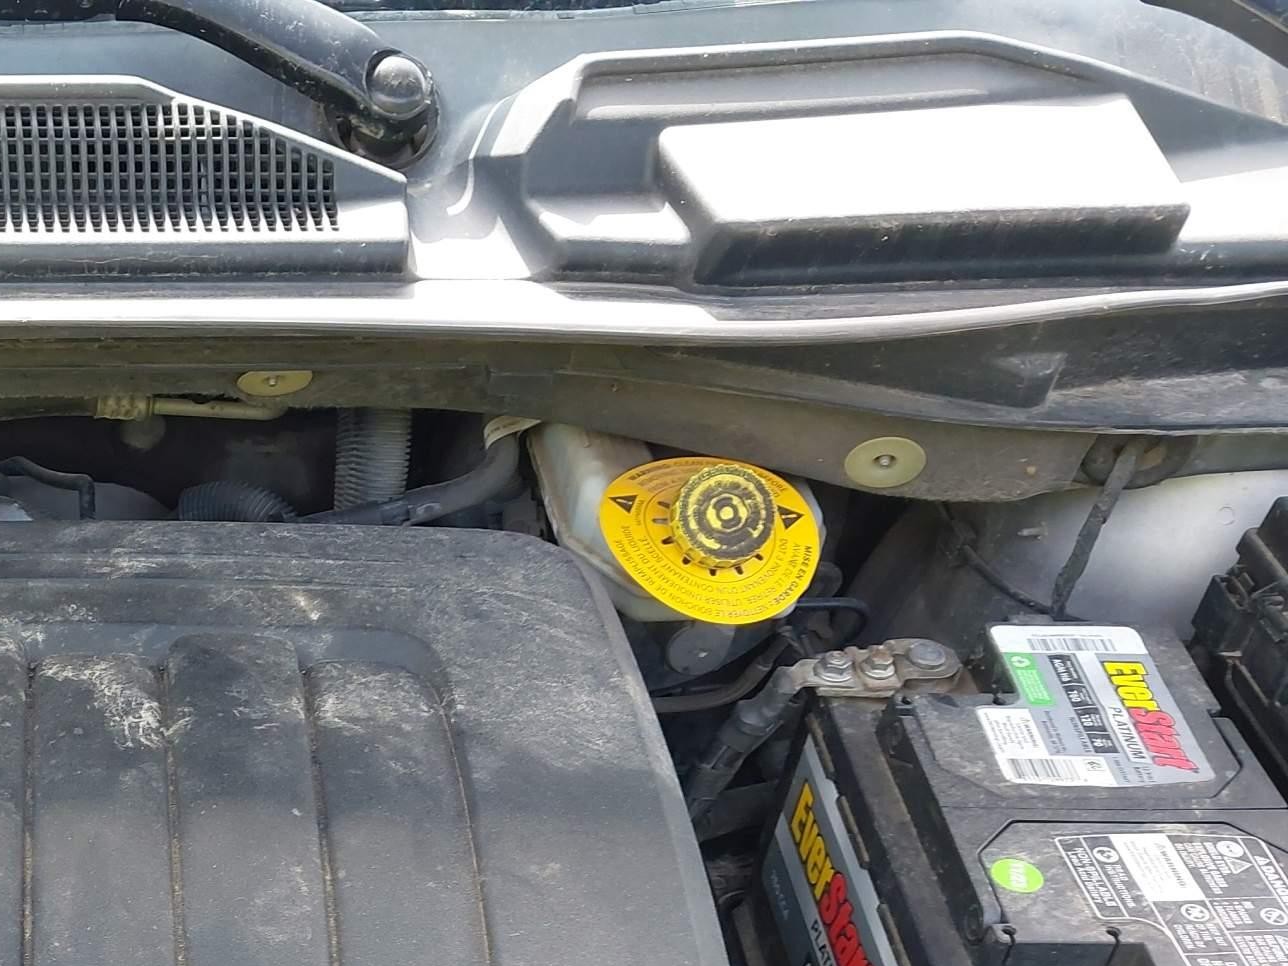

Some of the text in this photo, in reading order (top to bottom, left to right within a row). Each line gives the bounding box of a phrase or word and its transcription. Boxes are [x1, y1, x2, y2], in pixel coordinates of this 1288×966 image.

[802, 545, 812, 566] MISE
[796, 568, 807, 581] EN
[1101, 661, 1196, 768] EverStart
[1108, 707, 1146, 761] PLATINUM
